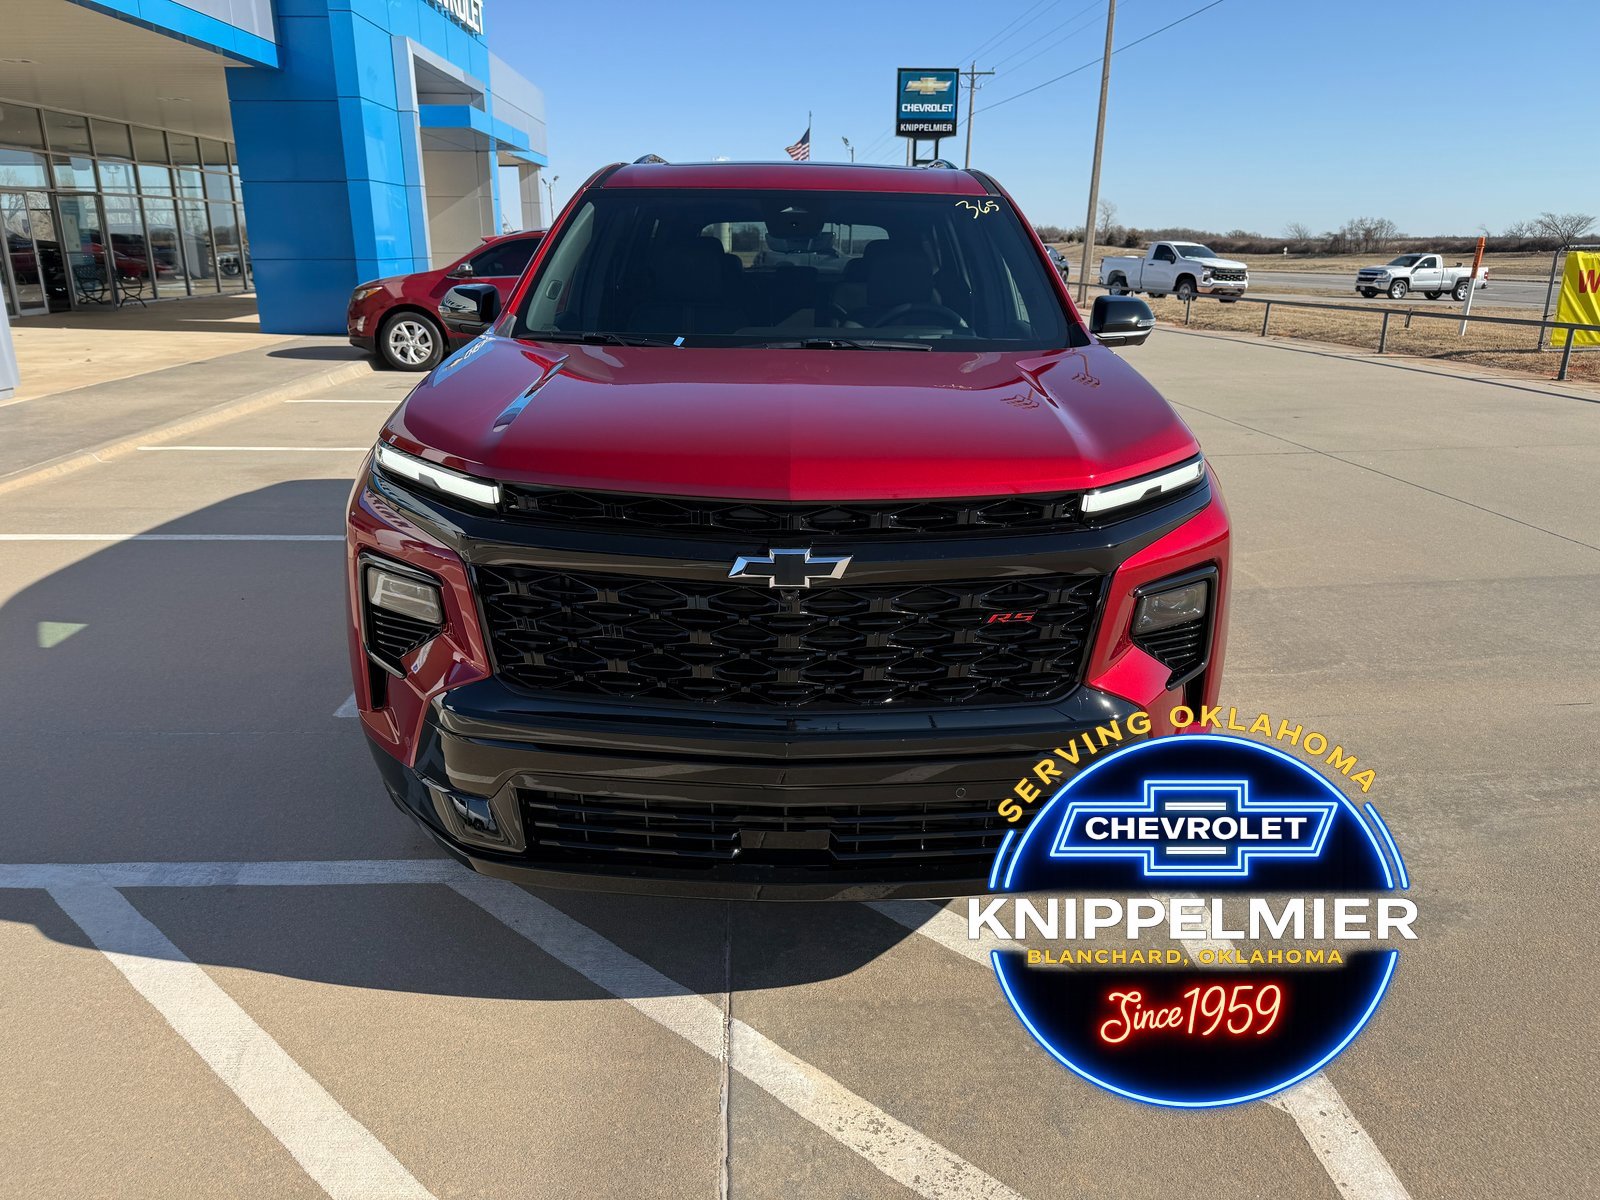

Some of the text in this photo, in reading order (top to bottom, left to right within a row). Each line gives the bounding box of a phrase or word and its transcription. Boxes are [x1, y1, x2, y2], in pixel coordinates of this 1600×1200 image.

[901, 103, 954, 113] CHEVROLET
[900, 123, 953, 132] KNIPPELMIER
[955, 199, 1000, 219] 365
[987, 611, 1037, 623] RS
